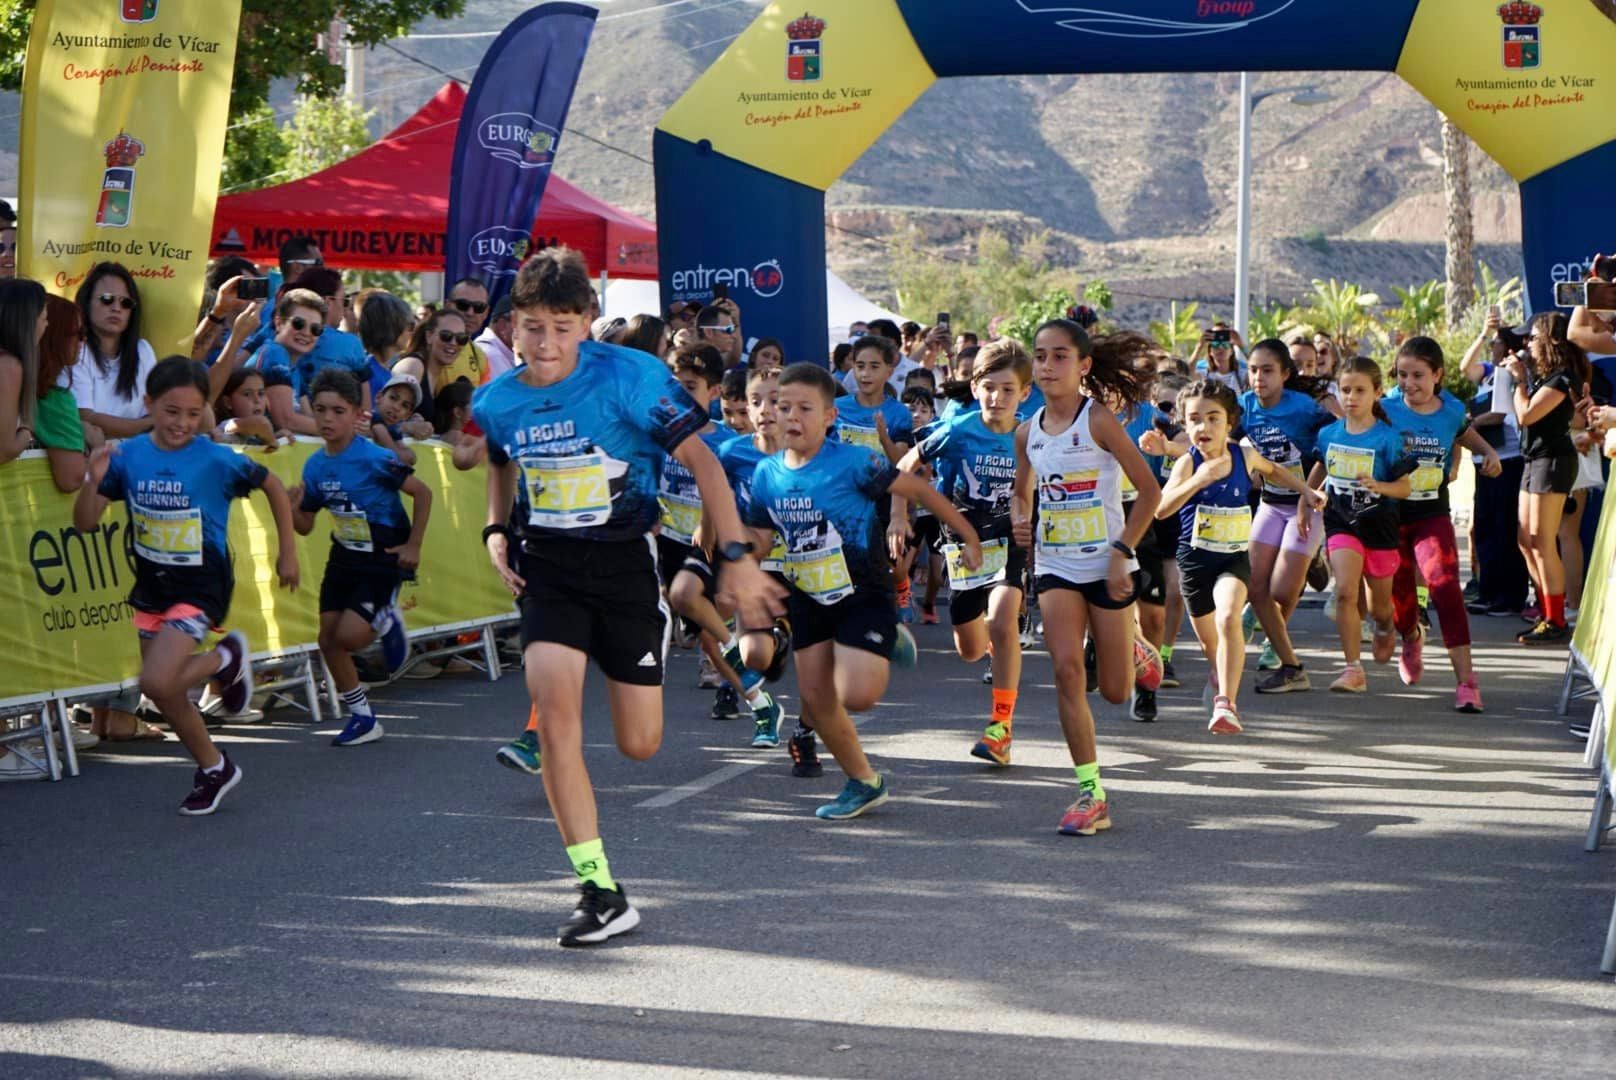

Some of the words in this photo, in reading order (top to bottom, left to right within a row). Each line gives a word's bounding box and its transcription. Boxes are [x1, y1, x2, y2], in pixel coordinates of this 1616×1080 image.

[51, 31, 150, 51] Ayuntamiento
[152, 32, 173, 49] de
[178, 34, 221, 54] Vícar
[63, 62, 123, 86] Corazón
[140, 54, 205, 74] Poniente
[737, 90, 819, 104] Ayuntamiento
[822, 88, 837, 99] de
[840, 86, 873, 98] Vícar
[1455, 77, 1538, 92] Ayuntamiento
[1541, 76, 1556, 88] de
[1560, 75, 1596, 88] Vícar
[744, 112, 791, 127] Corazón
[793, 106, 812, 120] del
[815, 101, 862, 118] Poniente
[1466, 98, 1510, 114] Corazón
[1512, 95, 1532, 109] del
[1533, 91, 1585, 108] Poniente
[124, 239, 144, 256] de
[148, 240, 193, 262] Vícar
[529, 419, 576, 442] ROAD
[1415, 436, 1440, 447] ROAD
[985, 454, 1013, 467] ROAD
[148, 480, 183, 494] ROAD
[545, 475, 606, 506] 572
[136, 493, 190, 508] RUNNING
[783, 496, 812, 510] ROAD
[151, 526, 198, 548] 574
[1057, 513, 1101, 540] 591
[800, 561, 847, 589] 575
[42, 604, 77, 633] club
